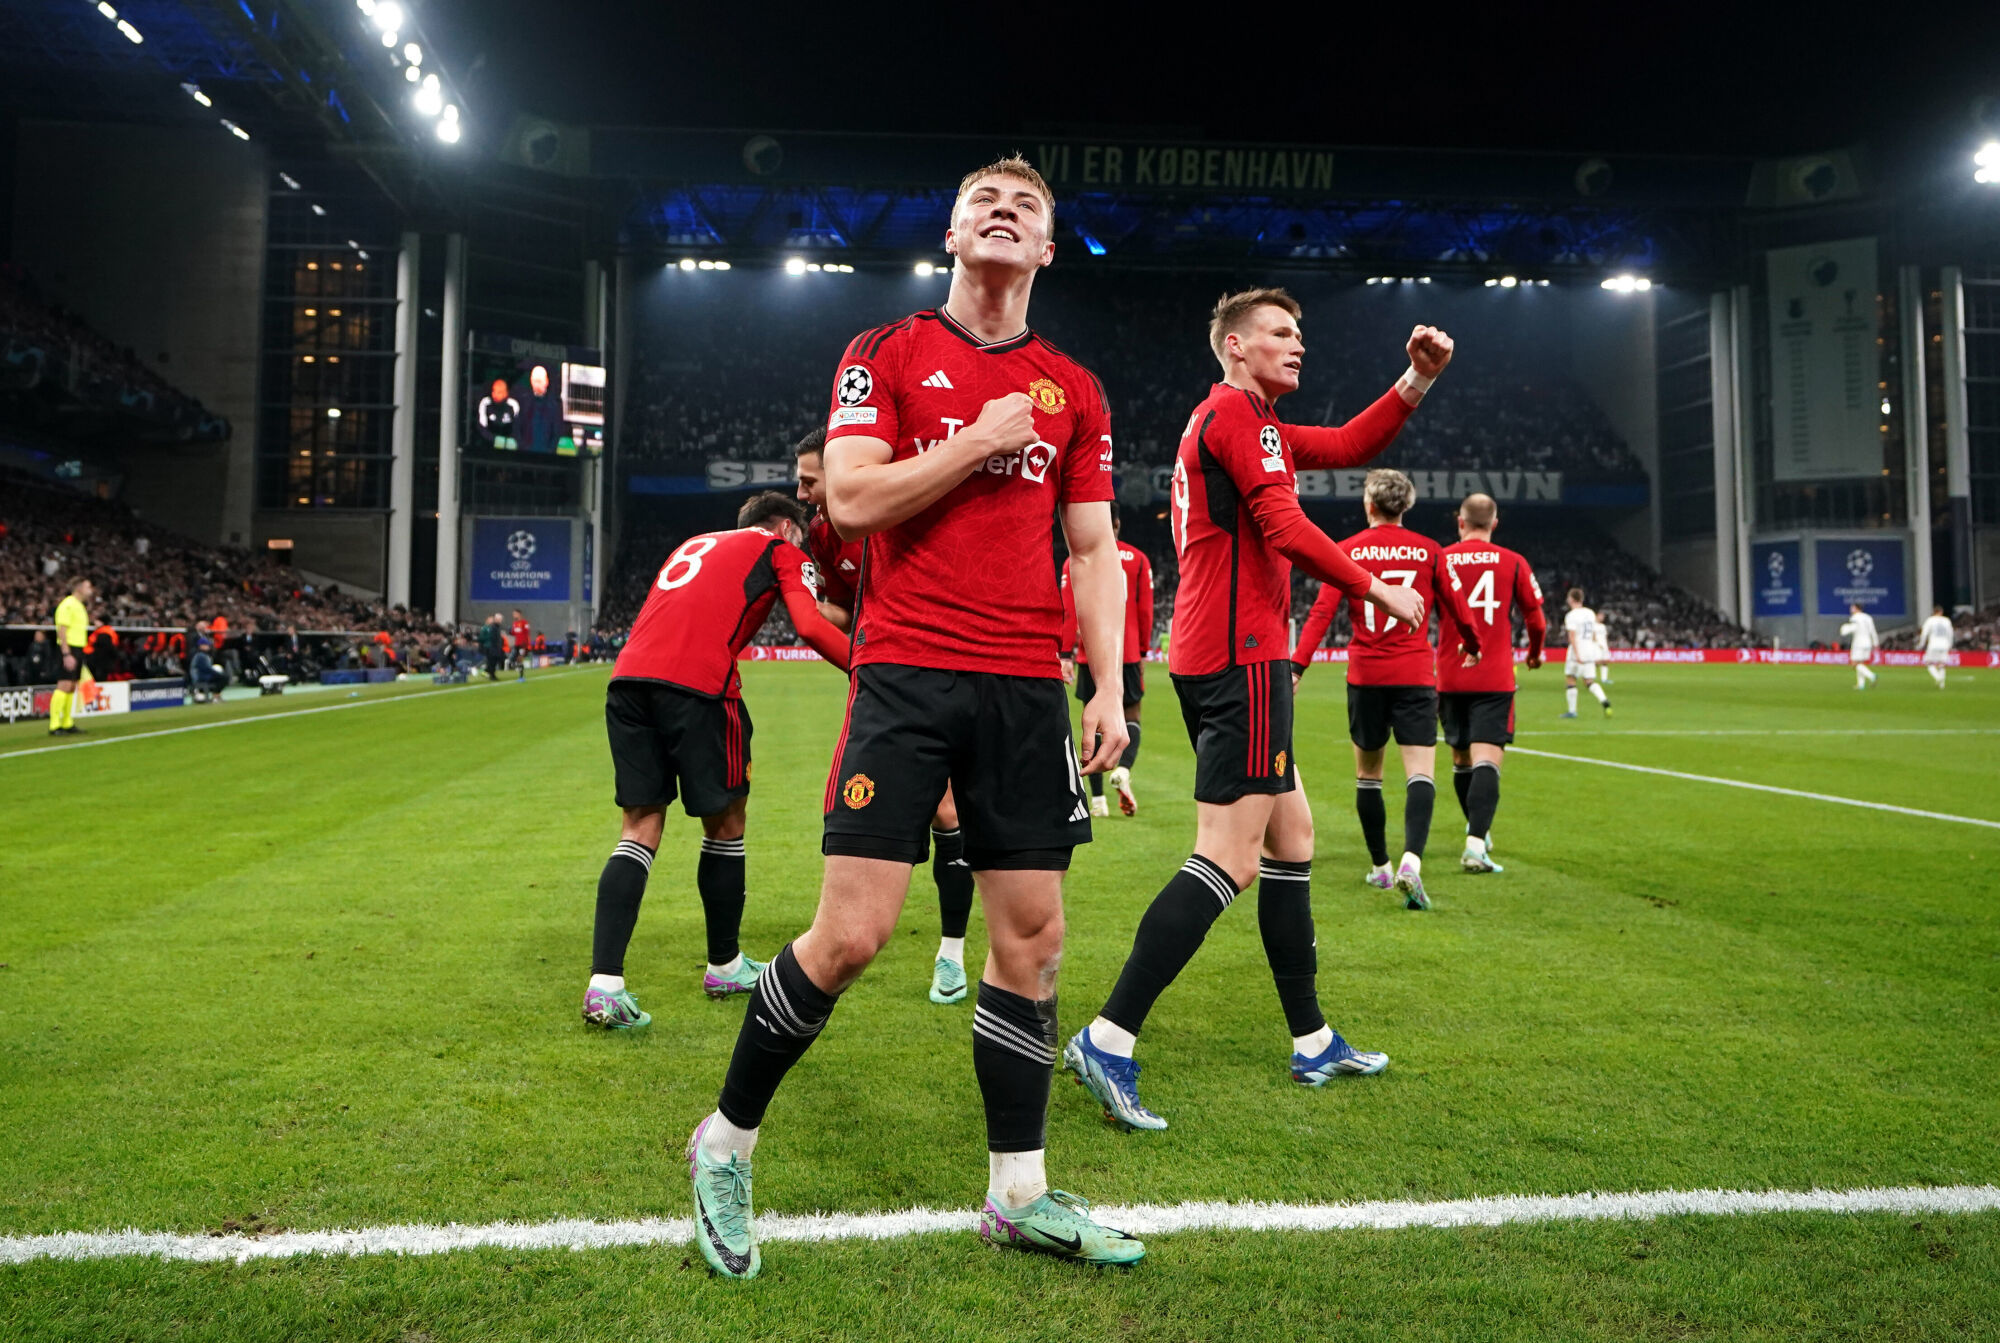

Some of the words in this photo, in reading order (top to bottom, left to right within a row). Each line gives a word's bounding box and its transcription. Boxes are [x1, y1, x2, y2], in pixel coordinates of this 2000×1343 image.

[1038, 145, 1070, 183] VI
[1083, 147, 1123, 185] ER
[1135, 147, 1335, 191] KØBENHAVN
[706, 461, 799, 488] SE
[1296, 466, 1561, 503] BEHAVN
[1170, 455, 1190, 557] 9
[657, 537, 717, 591] 8
[1120, 550, 1134, 561] RD
[1351, 546, 1428, 562] GARNACHO
[490, 571, 552, 580] CHAMPIONS
[501, 580, 540, 589] LEAGUE
[1608, 650, 1652, 662] URKISH
[1653, 650, 1705, 662] AIRLINES
[1759, 651, 1813, 663] TURKISH
[0, 686, 33, 724] epsi
